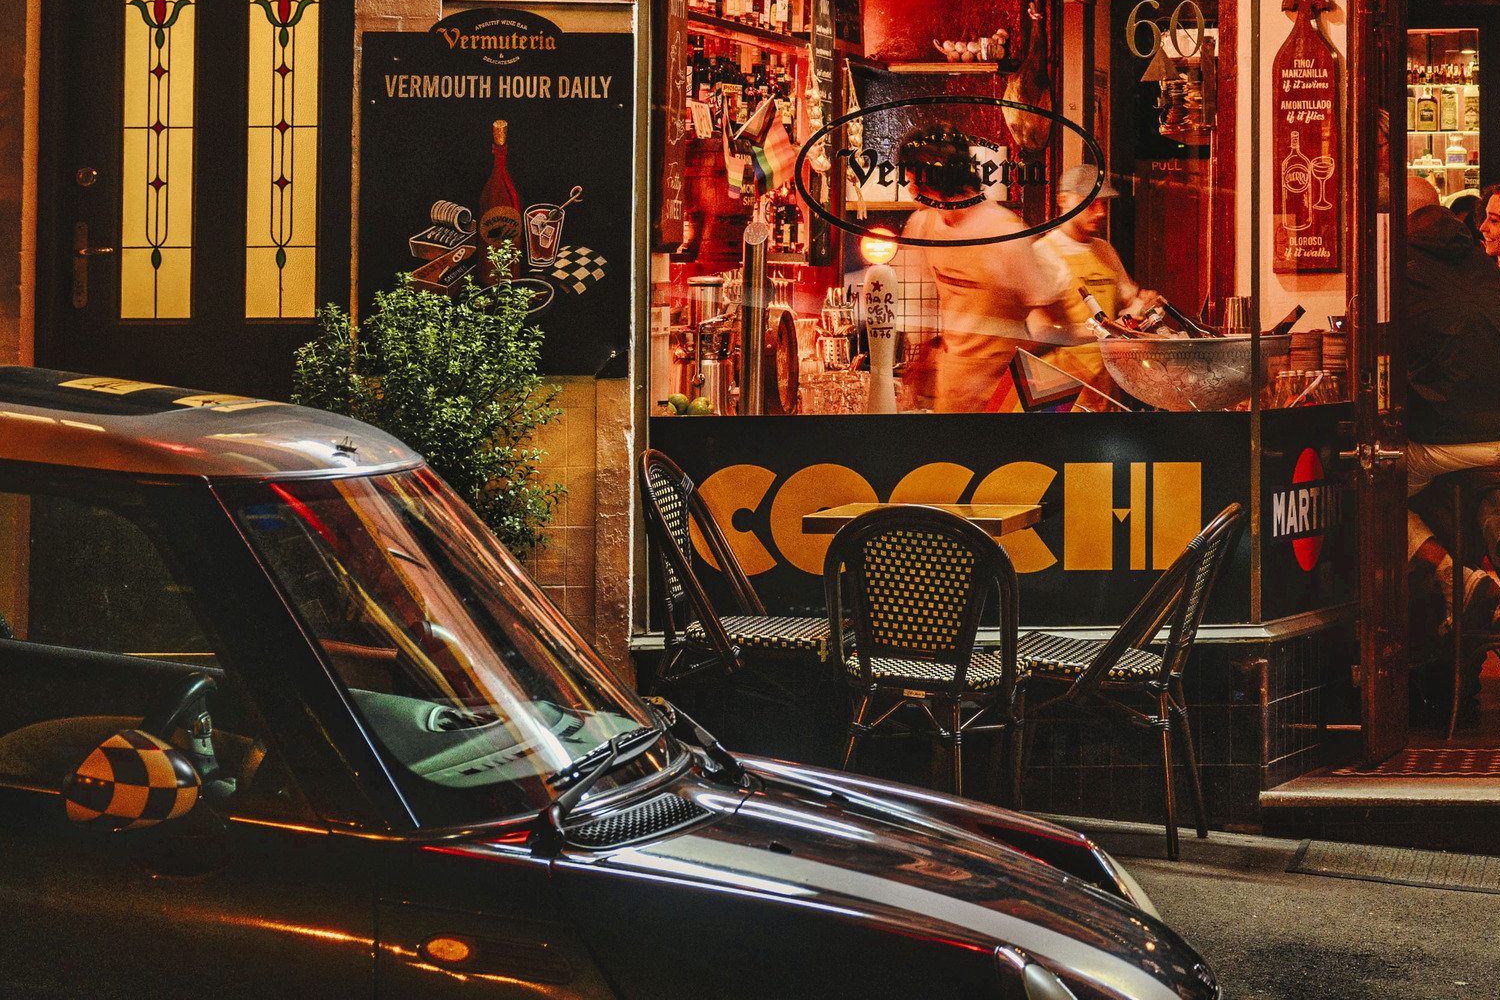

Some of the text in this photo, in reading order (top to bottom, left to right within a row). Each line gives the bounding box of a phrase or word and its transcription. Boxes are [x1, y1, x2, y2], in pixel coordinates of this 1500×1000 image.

[1126, 0, 1205, 58] 60
[436, 27, 557, 50] Vermuteria
[1282, 69, 1328, 78] MANZANILLA
[385, 74, 612, 99] VERMOUTH HOUR DAILY
[1281, 100, 1331, 110] AMONTILLADO
[1286, 110, 1295, 124] if
[1297, 111, 1305, 121] it
[1152, 161, 1182, 171] PULL
[1289, 237, 1323, 246] OLOROSO
[1284, 246, 1330, 260] if it walks
